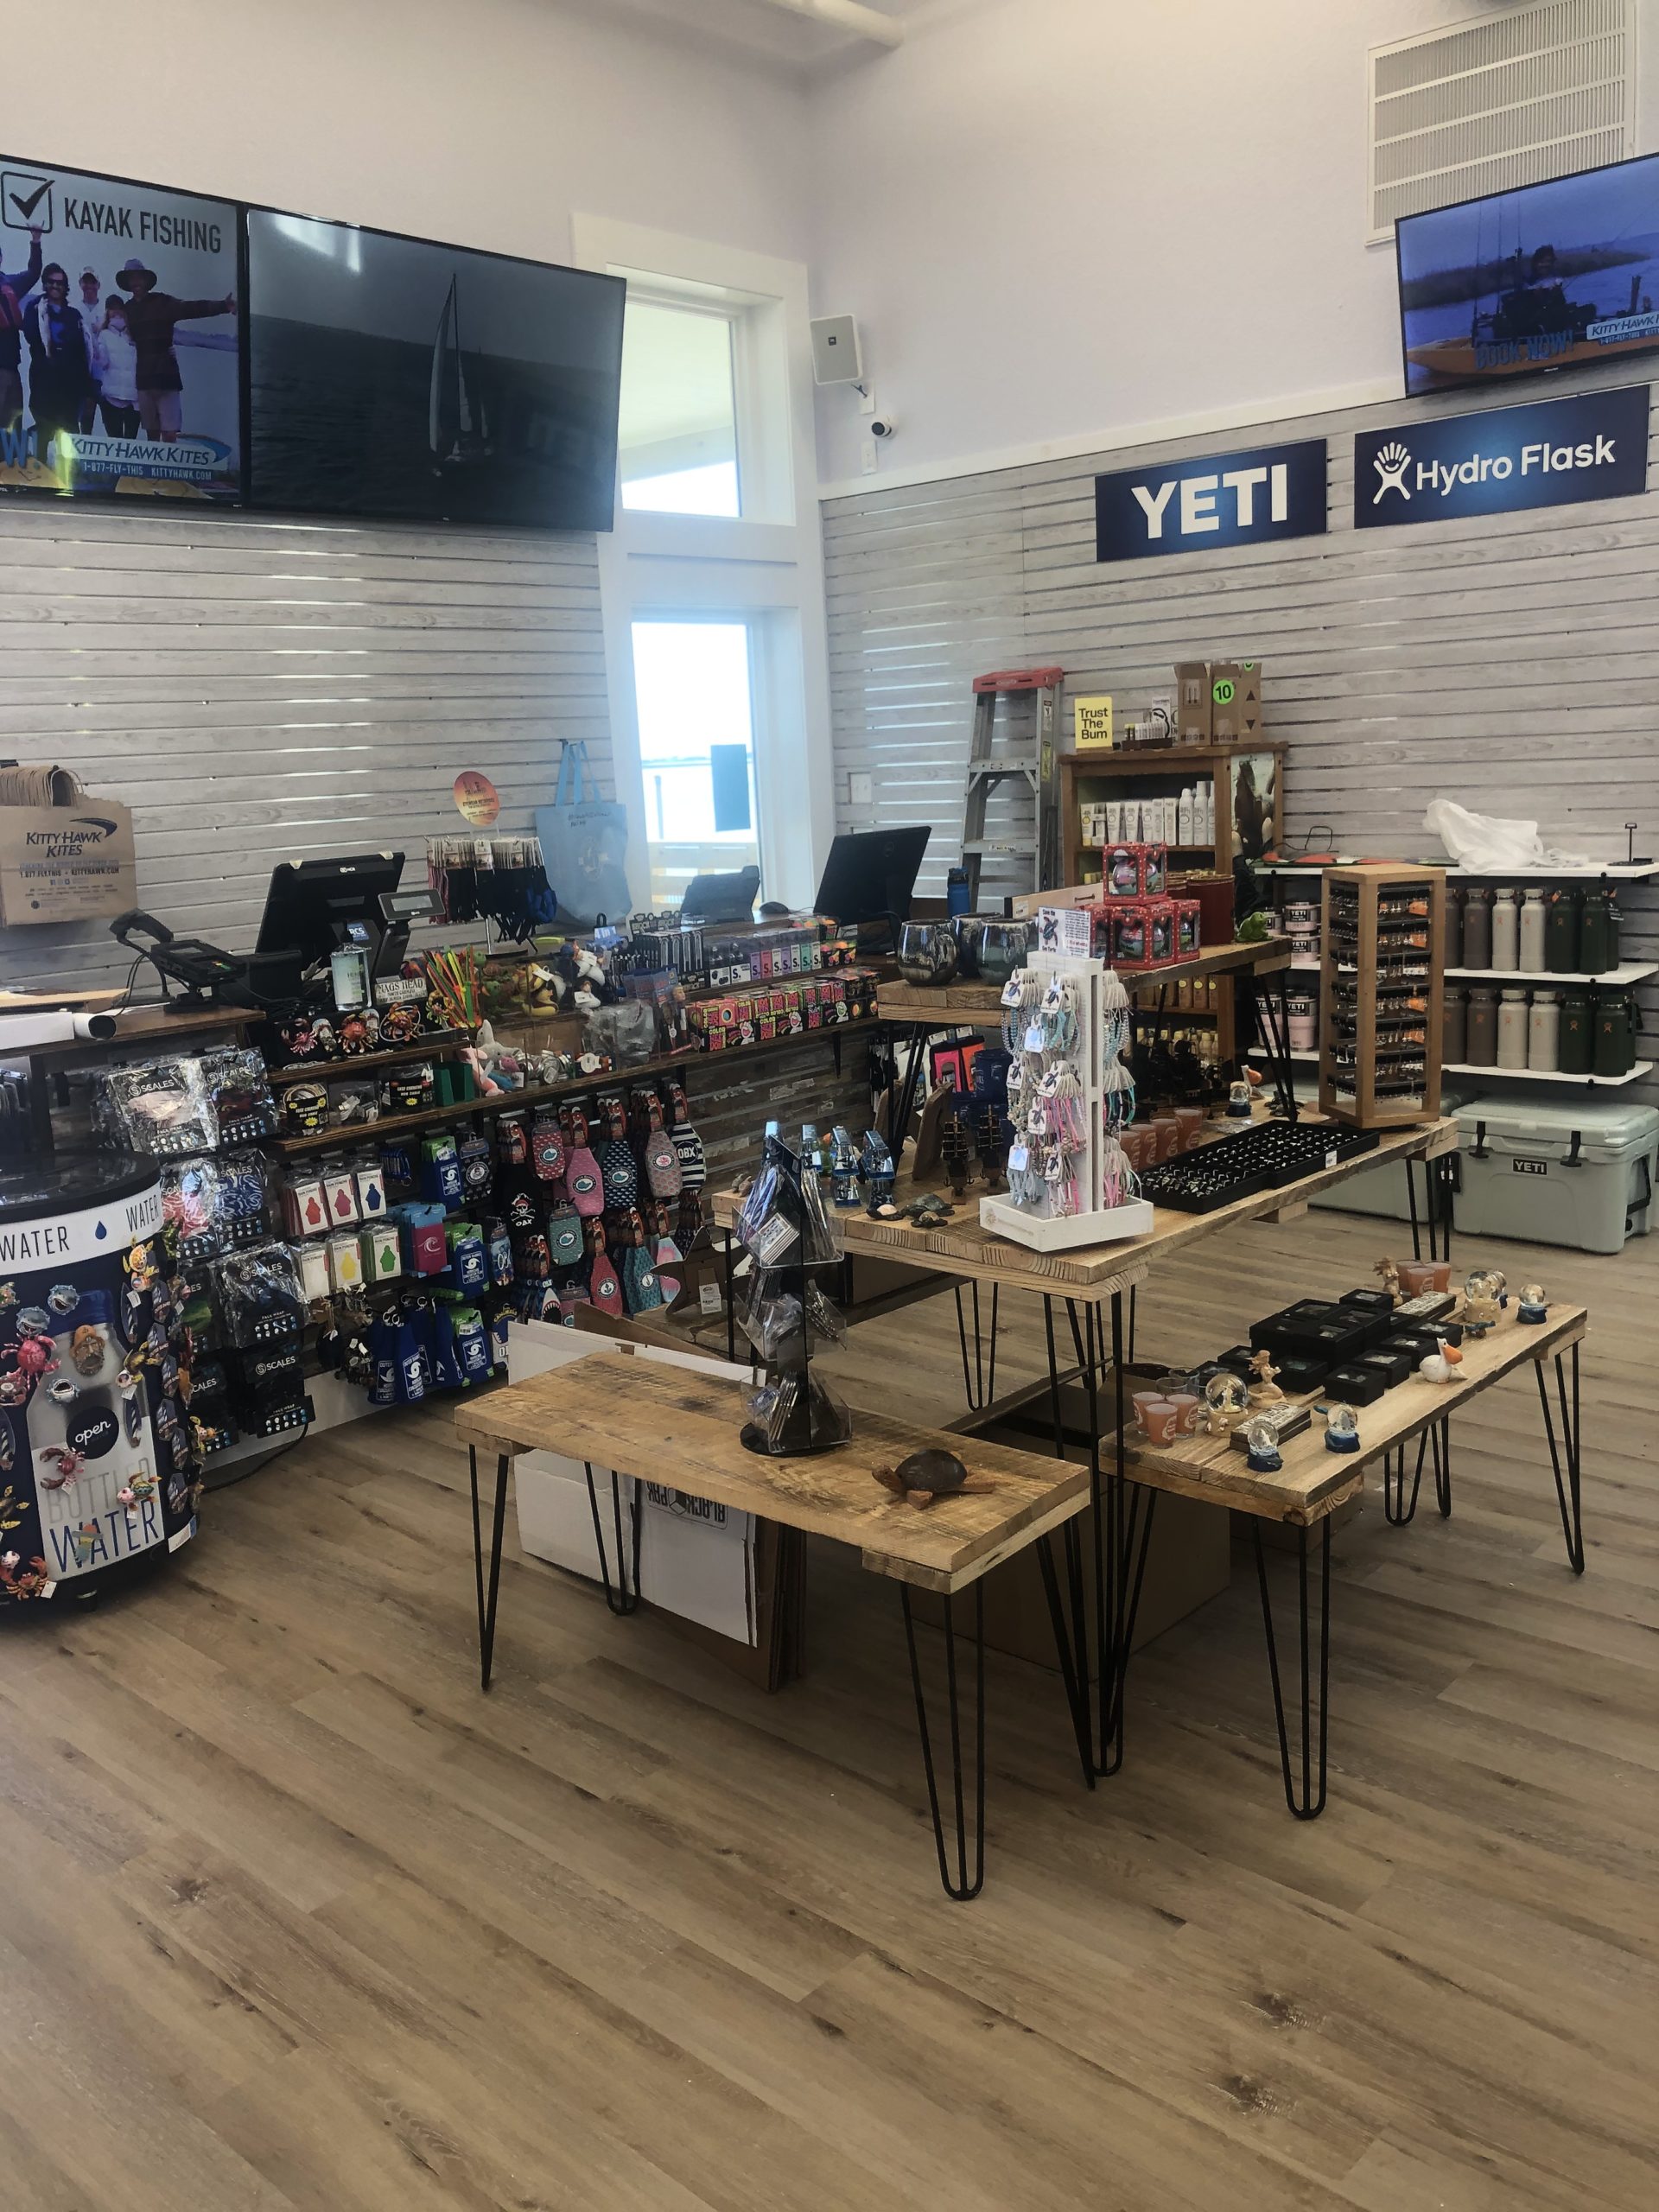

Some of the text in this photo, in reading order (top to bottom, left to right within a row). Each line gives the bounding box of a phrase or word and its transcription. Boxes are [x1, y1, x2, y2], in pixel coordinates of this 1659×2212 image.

[65, 197, 221, 254] KAYAK FISHING
[1591, 322, 1620, 337] KITTY
[1622, 316, 1654, 330] HAWK
[72, 437, 210, 466] KITTY HAWK KITES
[83, 461, 212, 480] 1-877-FLY-THIS KITTYHAWK.COM
[1416, 434, 1616, 498] Hydro Flask
[1131, 463, 1288, 539] YETI
[1215, 684, 1232, 700] 10
[1078, 707, 1109, 719] Trust
[1081, 718, 1103, 728] The
[1081, 729, 1108, 740] Bum
[26, 830, 103, 846] KITTY HAWK
[46, 843, 82, 858] KITES
[402, 978, 423, 990] HEAD
[141, 1079, 175, 1092] SCALES
[677, 1146, 696, 1159] OBX
[220, 1166, 252, 1179] SCALES
[1515, 1160, 1544, 1173] YETI
[0, 1194, 159, 1262] WATER WATER
[266, 1356, 296, 1371] SCALES
[192, 1377, 217, 1393] CALES
[75, 1419, 111, 1446] open
[49, 1498, 159, 1573] WATER
